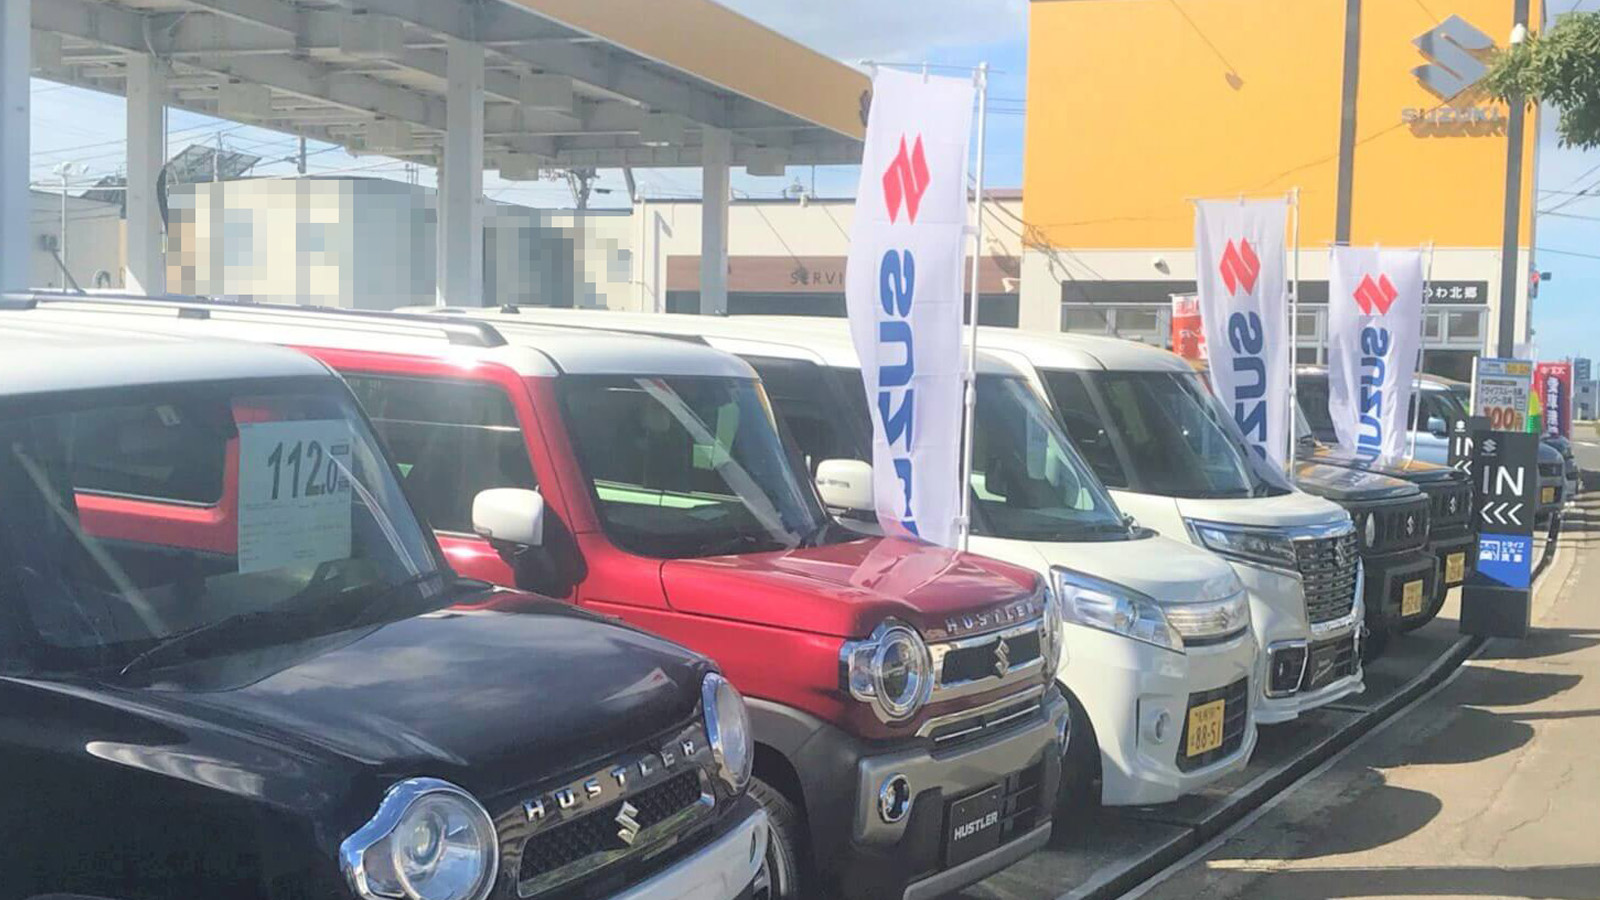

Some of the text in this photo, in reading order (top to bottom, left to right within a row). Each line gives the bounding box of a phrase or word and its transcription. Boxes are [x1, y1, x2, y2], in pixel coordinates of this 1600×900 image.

[267, 440, 339, 500] 112.0
[1482, 465, 1525, 497] IN
[944, 602, 1034, 633] HUSTLER
[1195, 721, 1220, 750] 88-51
[523, 740, 695, 823] HUSTLER
[954, 810, 998, 841] HUSTLER
